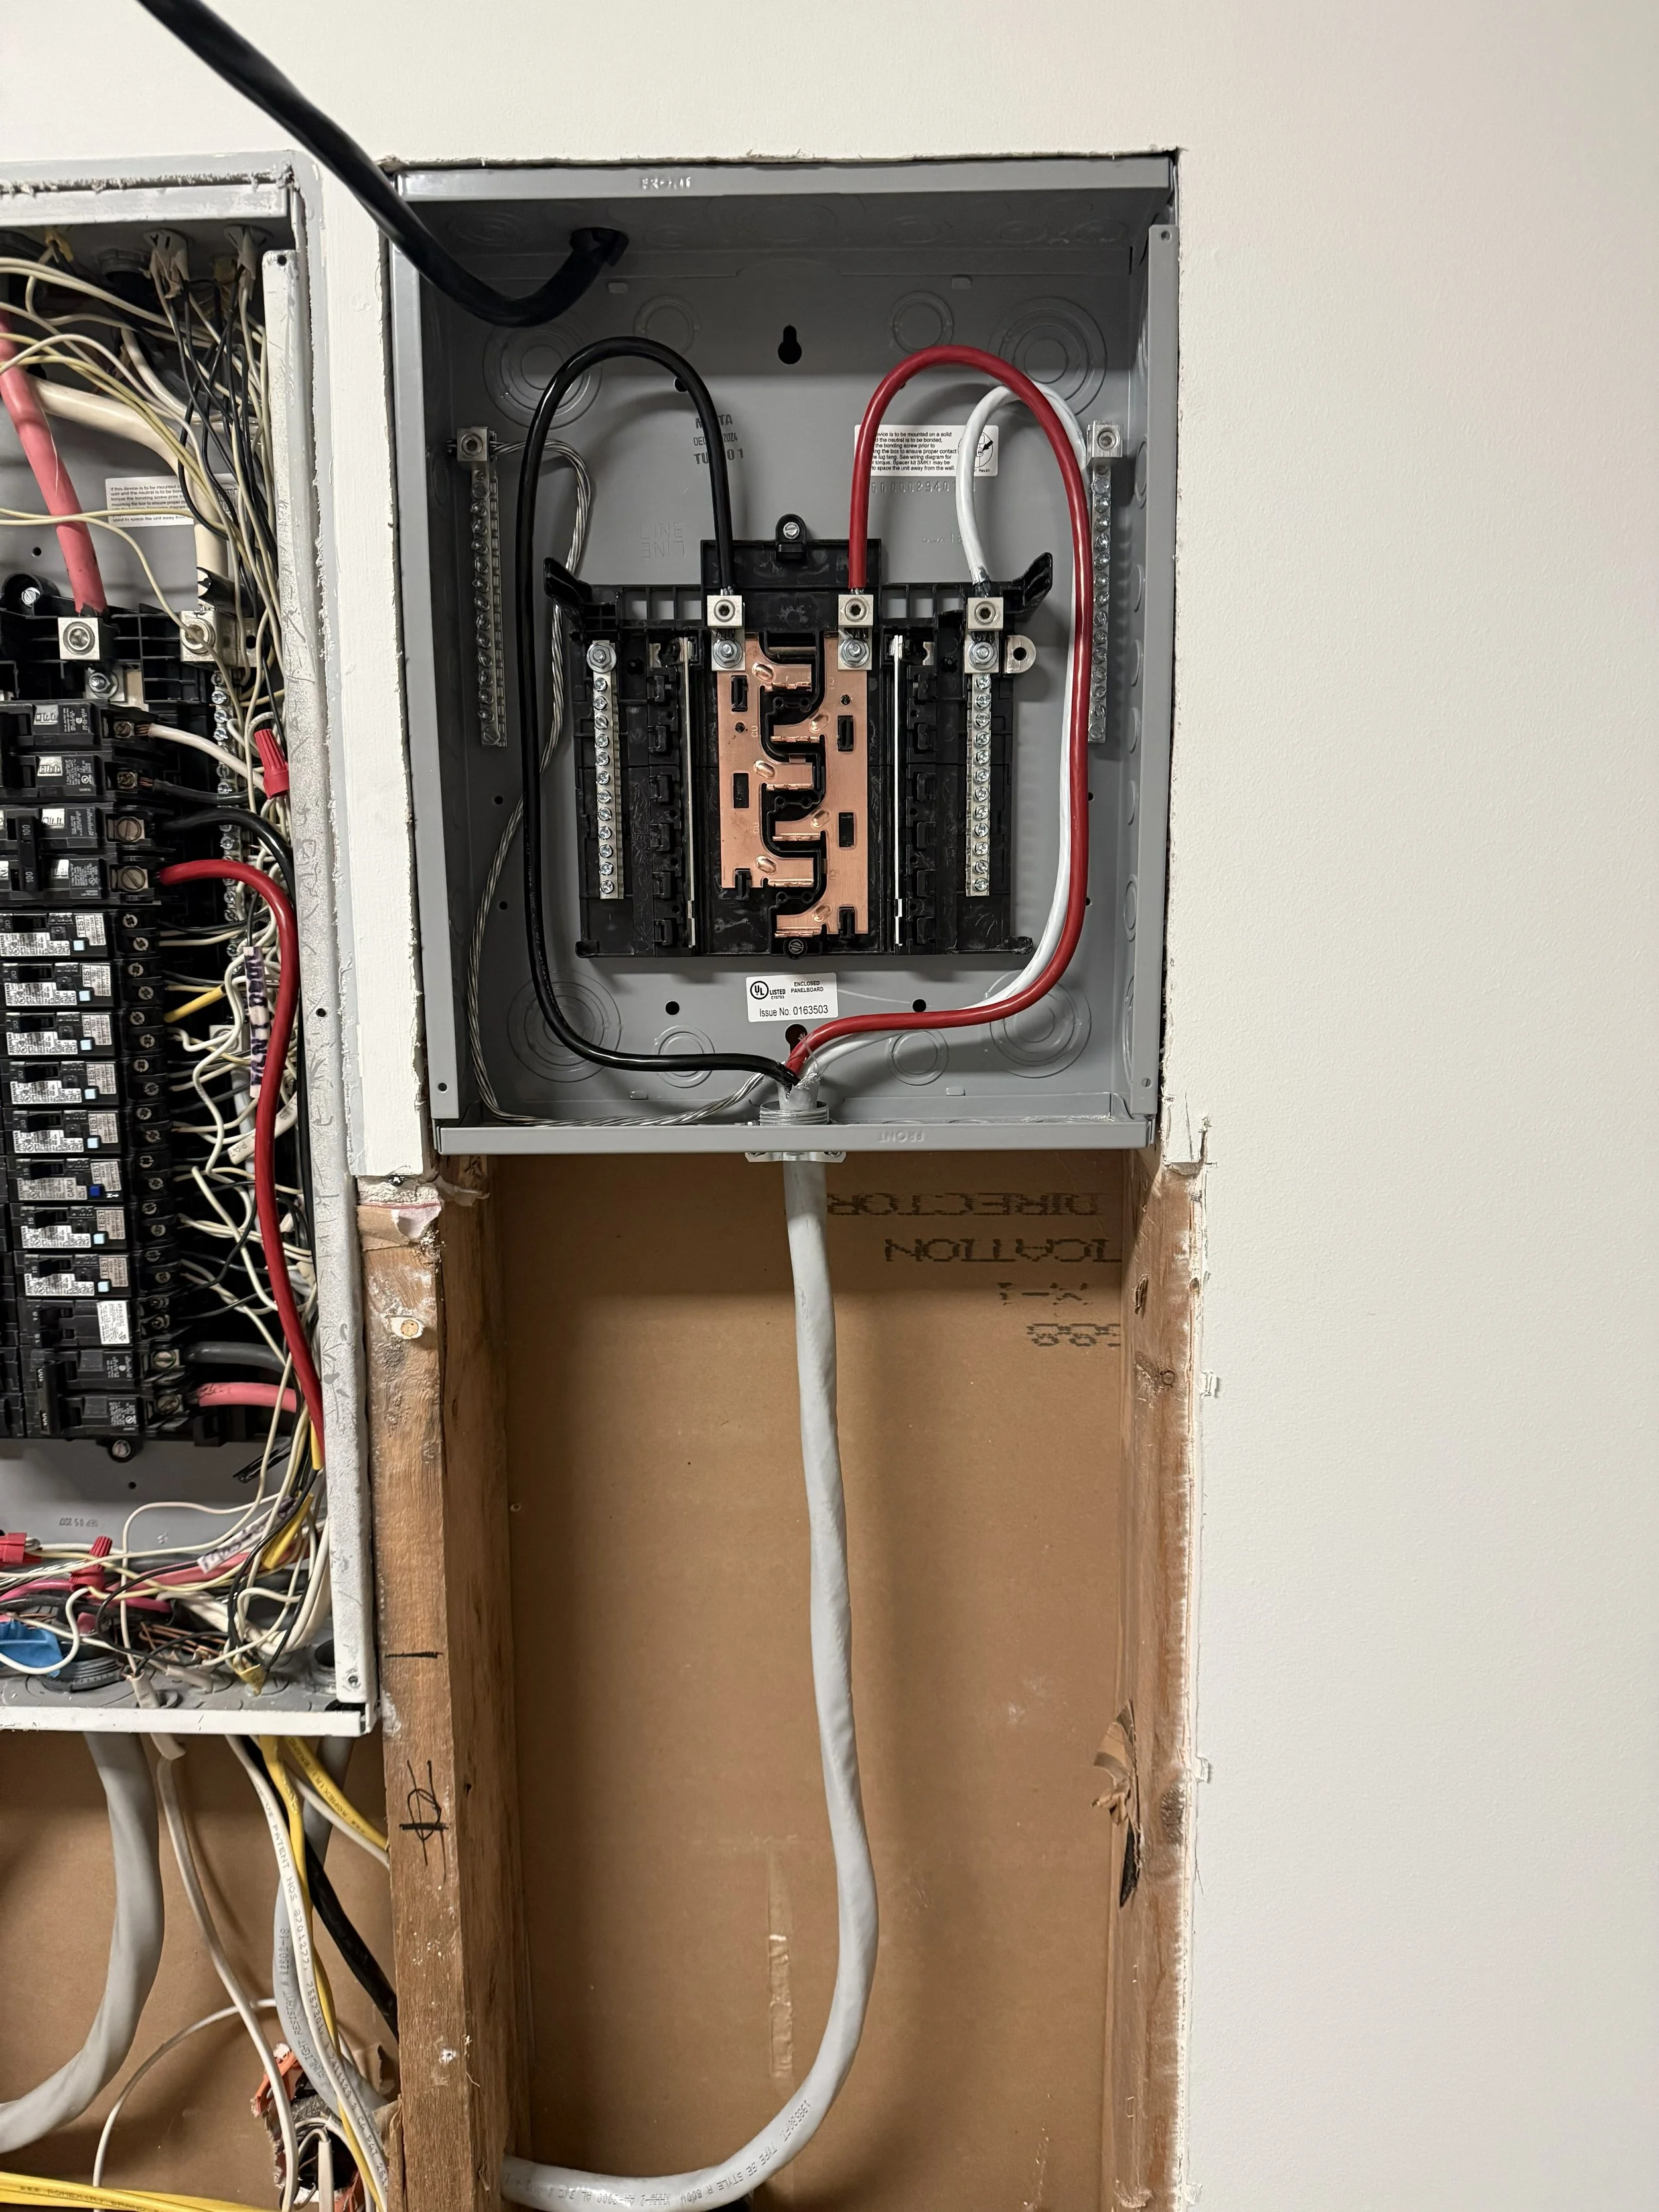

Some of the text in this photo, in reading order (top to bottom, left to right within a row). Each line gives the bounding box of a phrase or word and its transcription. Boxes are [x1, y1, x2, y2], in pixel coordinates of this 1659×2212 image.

[640, 522, 684, 539] LINE
[25, 871, 34, 882] 100
[759, 1005, 828, 1017] Issue No. 0163503
[96, 1211, 105, 1229] TEST
[885, 1238, 1122, 1262] ICATION
[272, 1824, 291, 1870] PATENT
[286, 1876, 298, 1901] NOS
[283, 1993, 303, 2036] RESISTANT
[717, 2172, 745, 2191] STYLE
